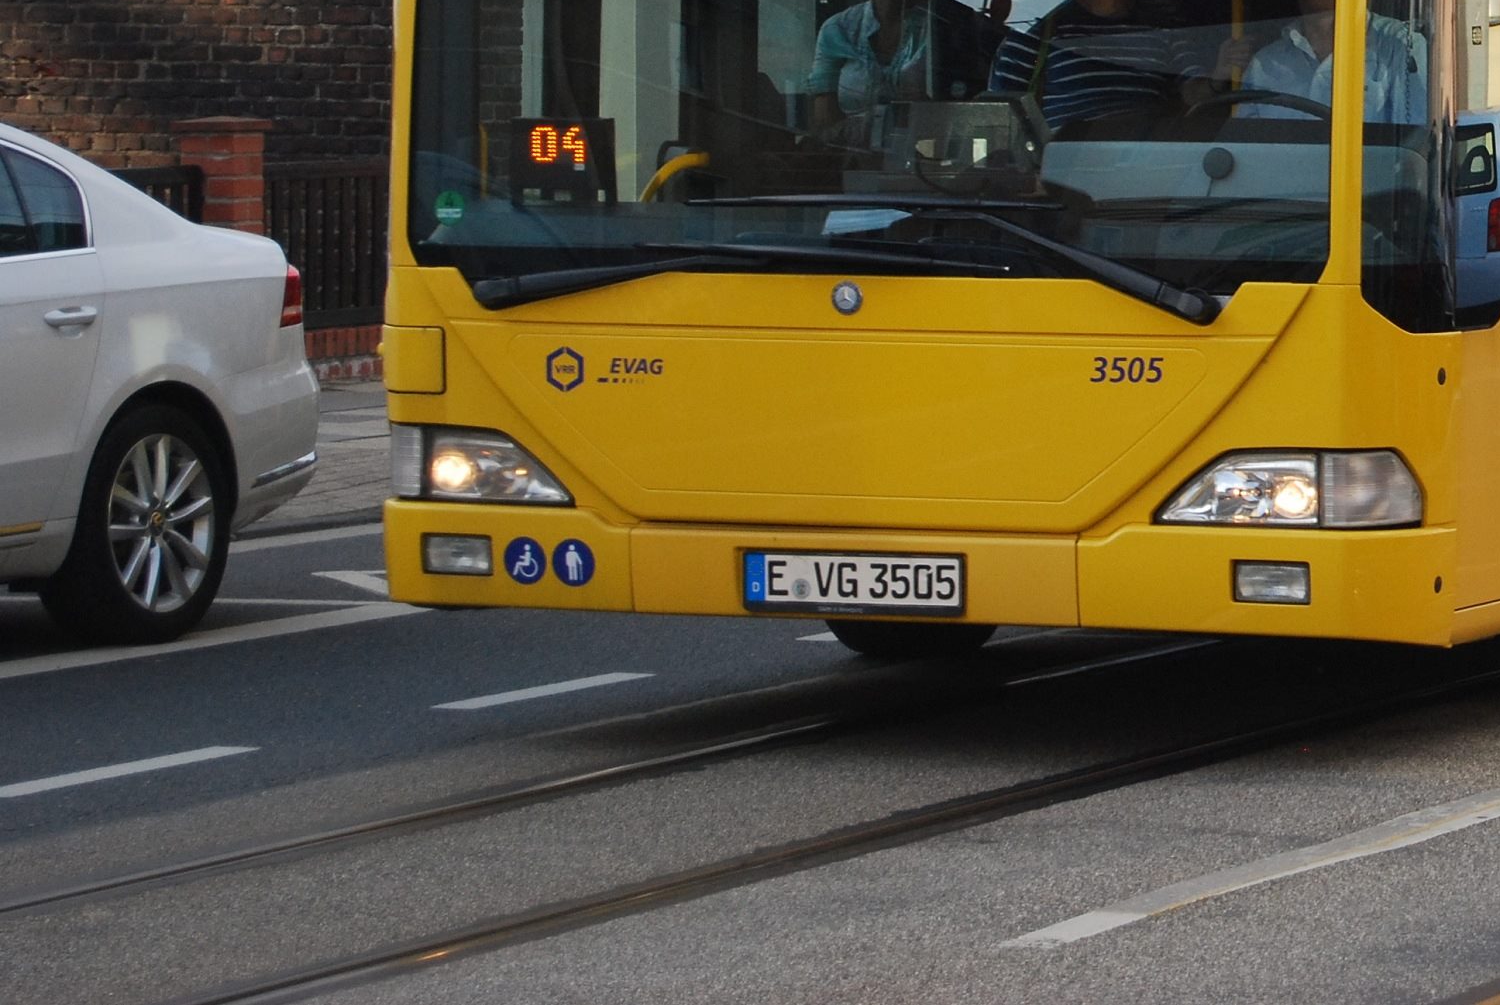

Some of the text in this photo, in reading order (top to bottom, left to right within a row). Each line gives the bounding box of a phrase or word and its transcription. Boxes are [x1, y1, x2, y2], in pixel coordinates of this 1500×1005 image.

[531, 126, 585, 163] 04
[609, 357, 664, 375] EVAG
[1090, 356, 1164, 383] 3505
[767, 560, 957, 601] E VG 3505
